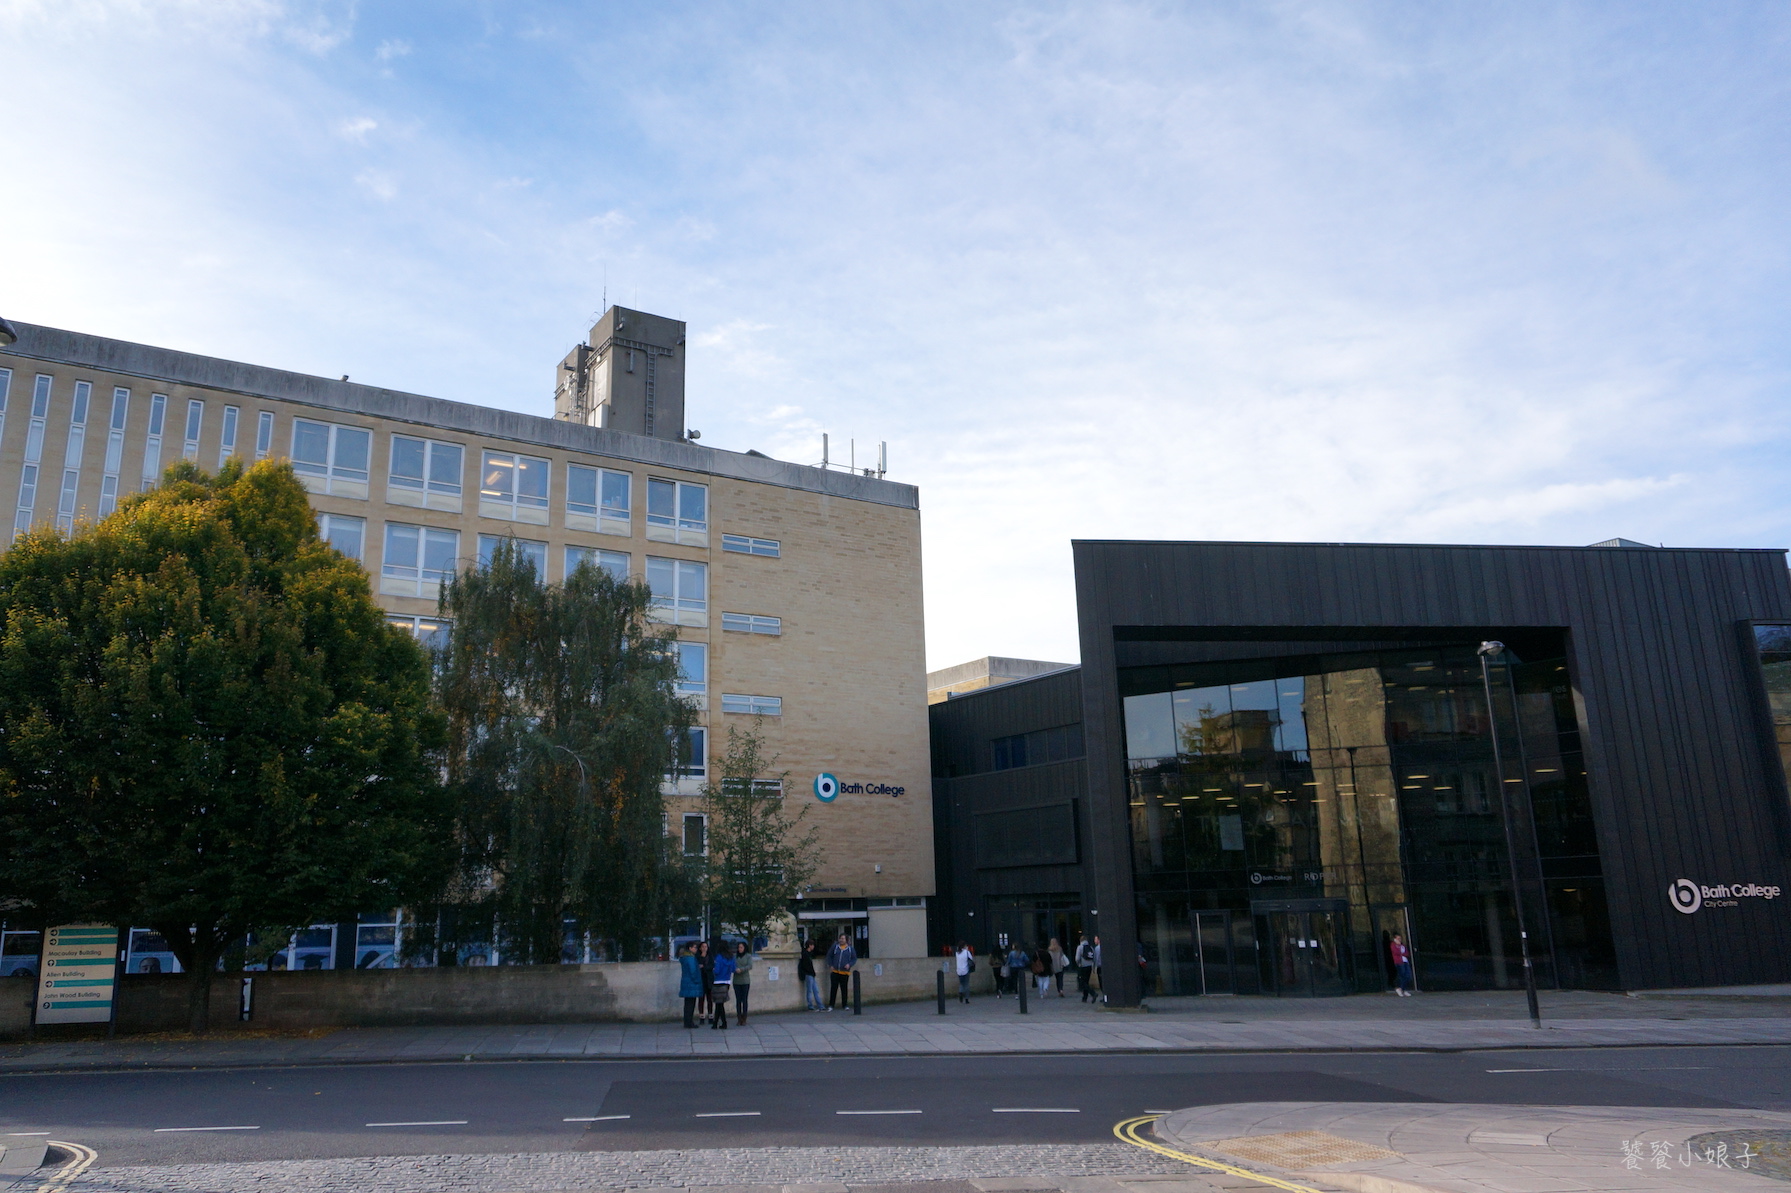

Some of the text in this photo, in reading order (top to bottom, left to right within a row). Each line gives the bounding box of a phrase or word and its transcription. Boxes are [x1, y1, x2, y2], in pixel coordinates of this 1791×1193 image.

[840, 782, 864, 794] Bath
[865, 783, 905, 798] College
[1701, 885, 1731, 899] Bath
[1731, 883, 1780, 900] College
